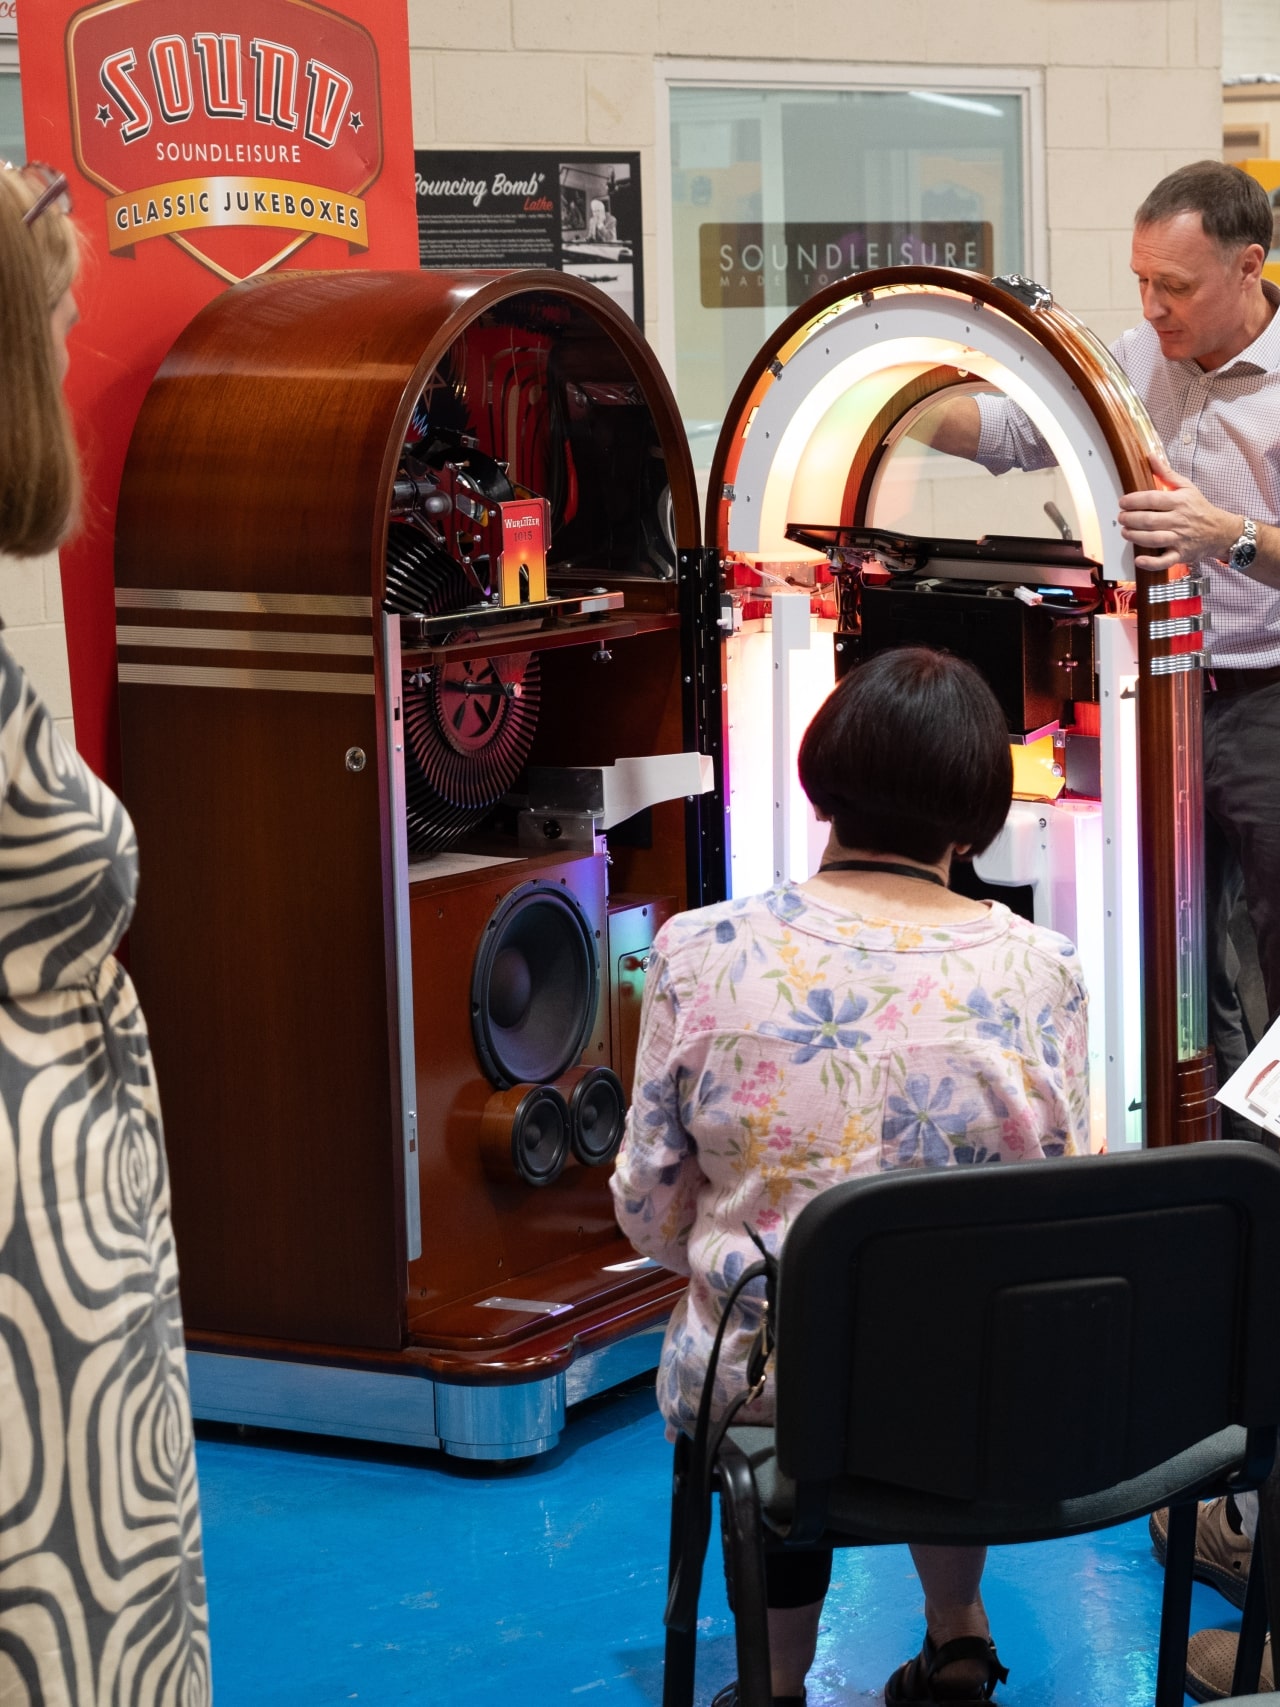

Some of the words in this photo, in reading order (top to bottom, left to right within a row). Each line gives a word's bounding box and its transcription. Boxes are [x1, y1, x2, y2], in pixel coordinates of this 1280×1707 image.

[100, 33, 353, 149] SOUND
[156, 142, 301, 163] SOUNDLEISURE
[116, 191, 210, 231] CLASSIC
[223, 190, 360, 229] JUKEBOXES
[523, 196, 554, 212] Lathe
[719, 241, 978, 272] SOUNDLEISURE
[719, 273, 783, 287] MADE
[804, 273, 829, 286] TO
[504, 516, 540, 529] WURLITZER
[514, 531, 533, 542] 1015
